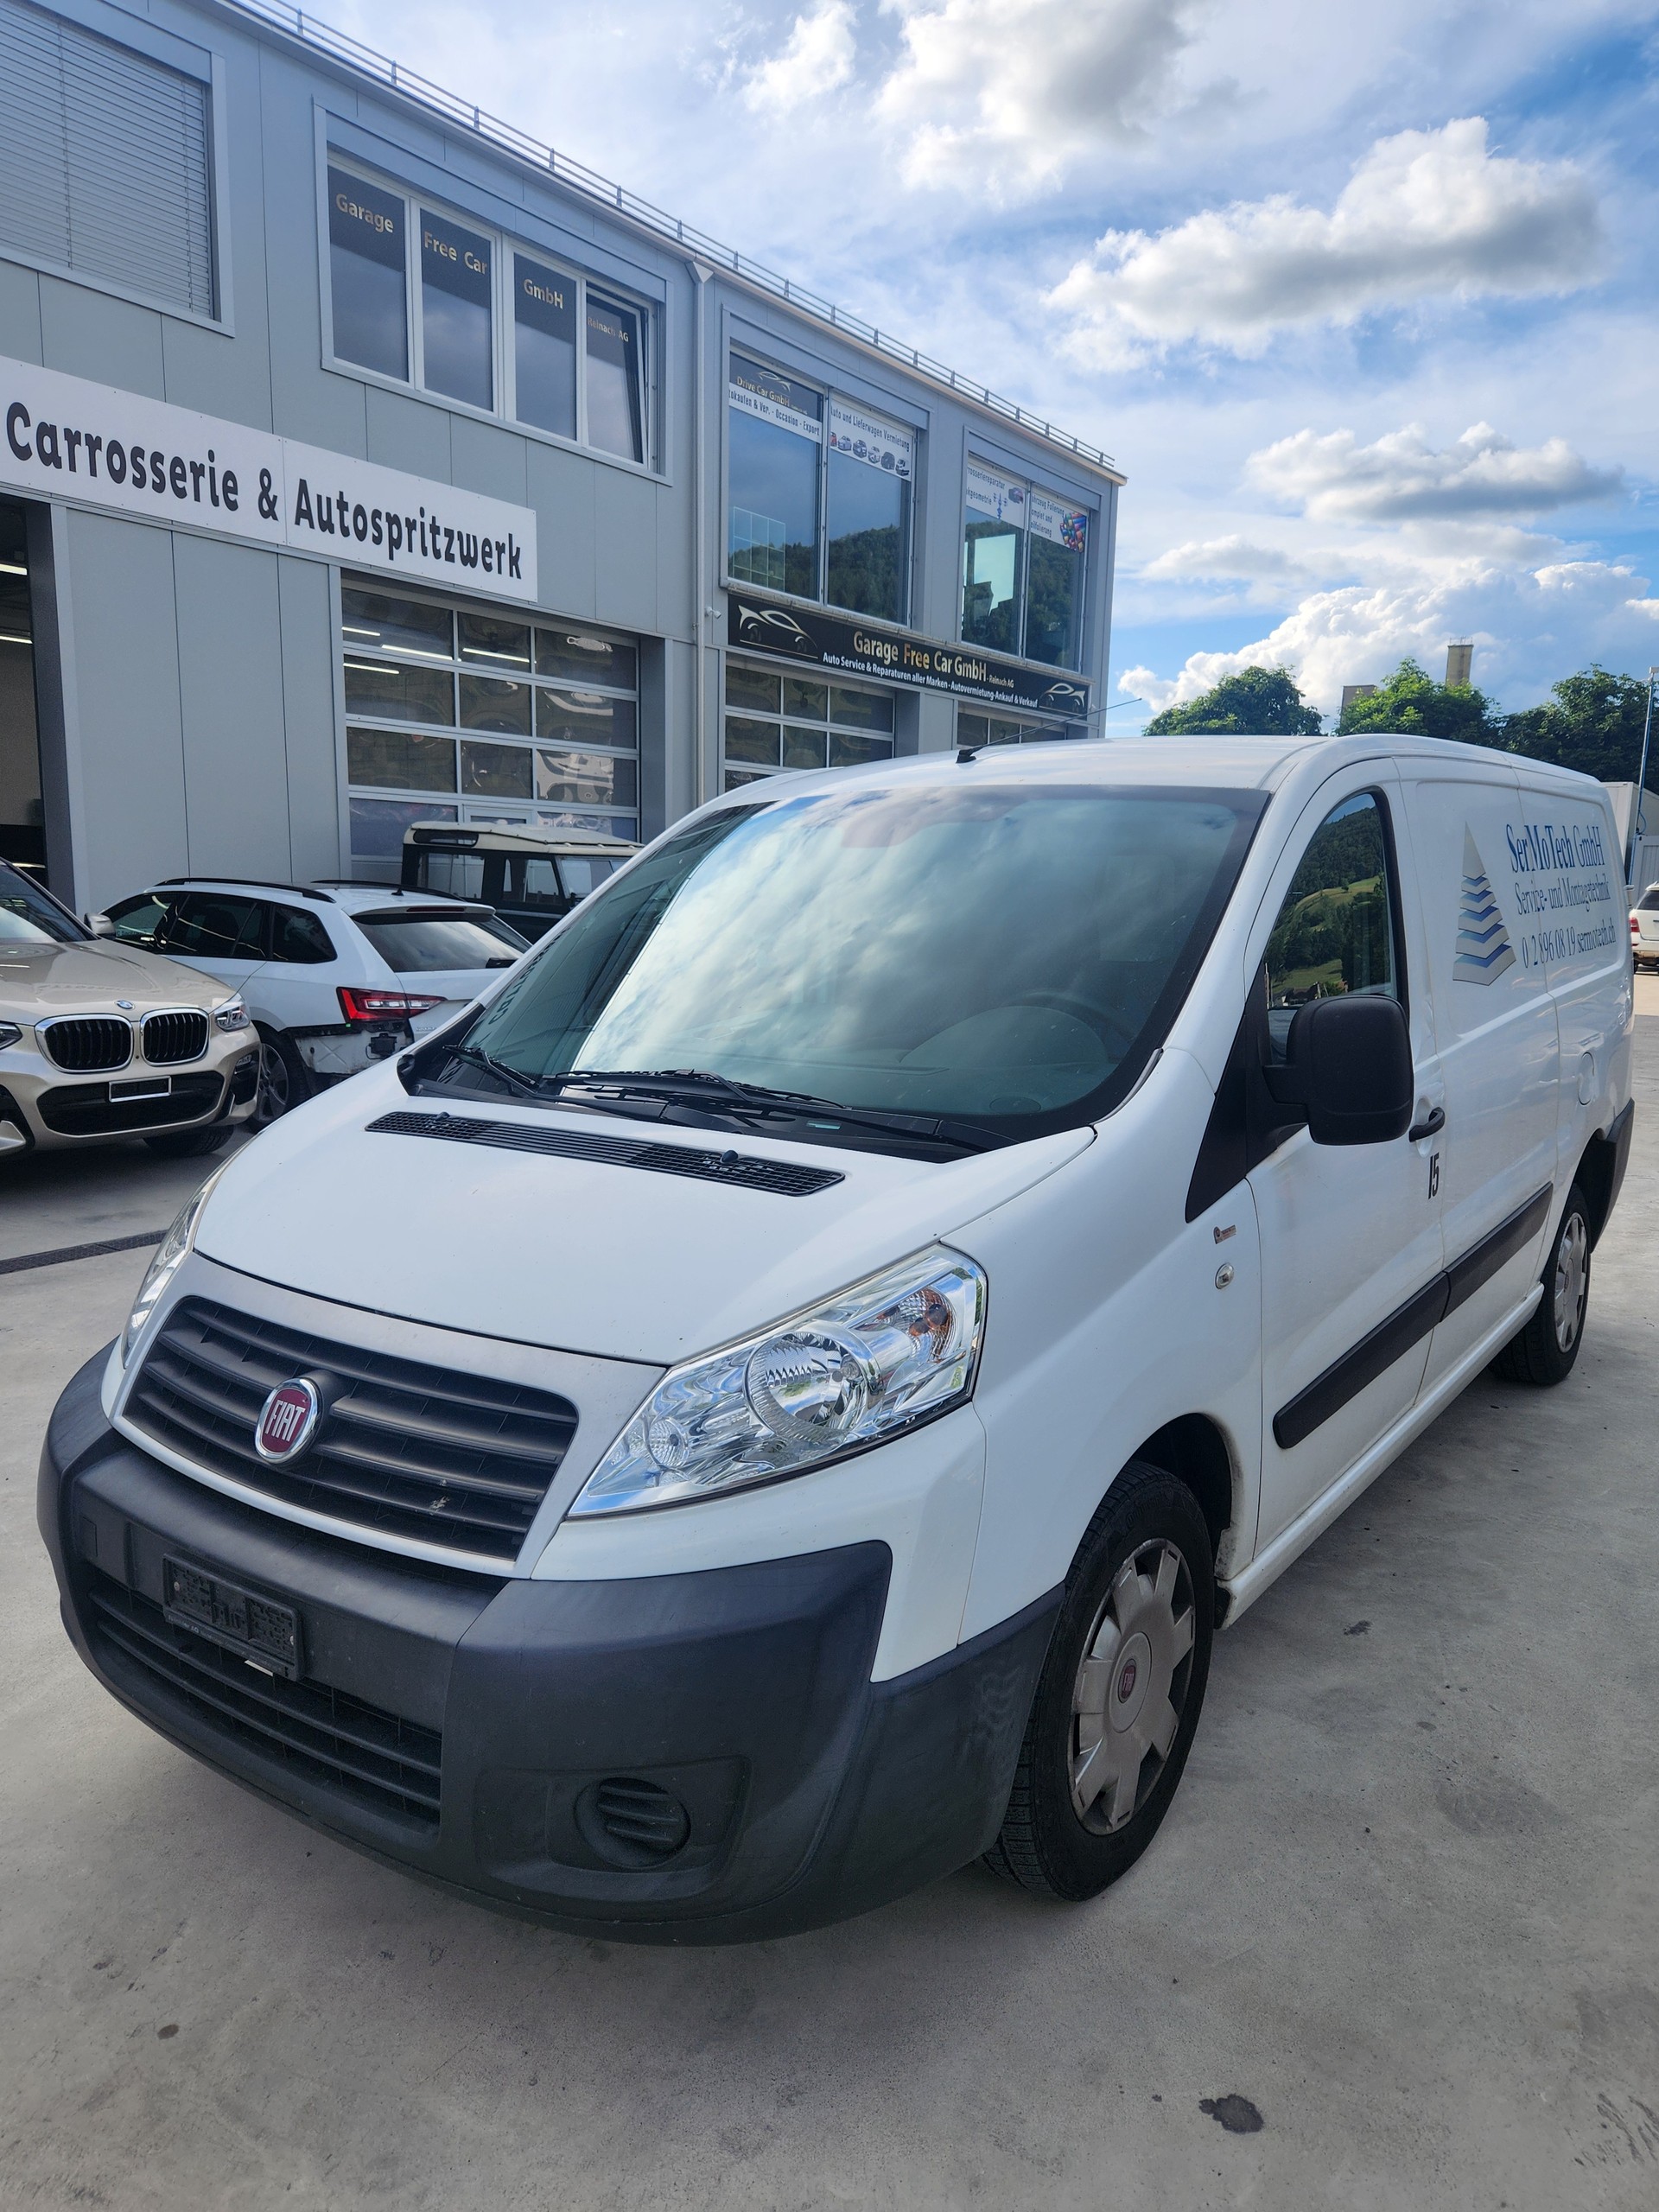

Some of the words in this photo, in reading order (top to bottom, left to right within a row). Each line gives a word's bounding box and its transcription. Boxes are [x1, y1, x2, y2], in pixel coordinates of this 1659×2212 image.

[335, 192, 394, 233] Garage
[424, 231, 457, 261] Free
[464, 251, 487, 275] Car
[524, 278, 563, 309] GmbH
[619, 329, 629, 342] AG
[737, 376, 755, 392] Drive
[757, 385, 768, 397] Car
[769, 391, 790, 407] GmbH
[775, 409, 798, 427] Occasion
[803, 421, 820, 435] Export
[842, 413, 852, 424] und
[853, 416, 882, 438] Lieferwagen
[7, 402, 238, 512] Carrosserie
[258, 467, 279, 521] &
[295, 477, 523, 579] Autospritzwerk
[823, 652, 841, 665] Auto
[841, 656, 865, 671] Service
[866, 662, 872, 672] &
[872, 664, 912, 681] Reparaturen
[912, 671, 925, 684] aller
[926, 675, 948, 689] Marken
[1014, 695, 1019, 704] &
[1019, 696, 1039, 709] Verkauf
[853, 631, 899, 665] Garage
[904, 643, 930, 670] Free
[934, 651, 952, 674] Car
[954, 656, 987, 682] GmbH
[989, 675, 1007, 687] Reinach
[1007, 679, 1014, 688] AG
[1573, 824, 1606, 868] GmbH
[1548, 878, 1564, 909] und
[1554, 928, 1565, 959] 08
[1567, 926, 1576, 957] 19
[1428, 1152, 1440, 1199] 15
[264, 1399, 306, 1442] FIAT
